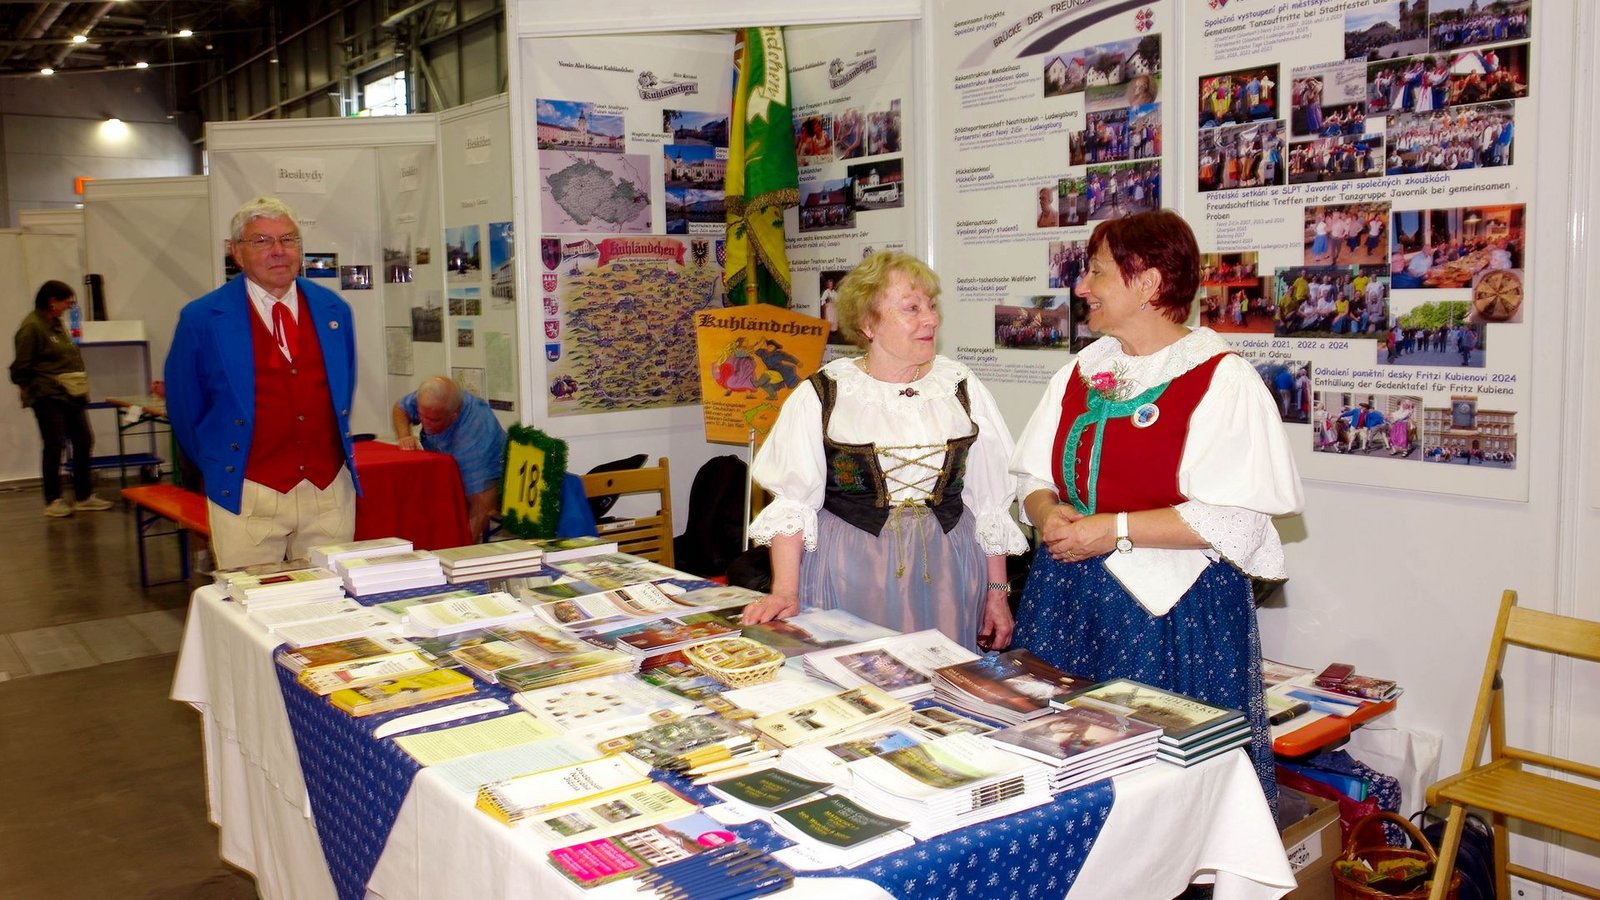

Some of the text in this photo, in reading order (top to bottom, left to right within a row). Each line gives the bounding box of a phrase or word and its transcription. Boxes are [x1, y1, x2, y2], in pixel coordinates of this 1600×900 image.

[1204, 1, 1370, 38] Gemeinsame Tanzauftritte bei Stadtfesten
[1238, 8, 1276, 22] vystoupení
[1278, 4, 1288, 14] při
[954, 16, 982, 28] Gemeinsame
[976, 22, 997, 32] projekty
[993, 22, 1022, 48] BRÜCKE
[1028, 12, 1043, 26] DER
[1044, 110, 1078, 122] Ludwigsburg
[1030, 122, 1062, 132] Ludwigsburg
[1242, 190, 1268, 198] setkání
[1282, 186, 1302, 194] SLPT
[1306, 183, 1338, 193] Javorník
[1342, 180, 1353, 192] při
[1356, 176, 1400, 190] společných
[1405, 174, 1450, 185] zkouškách
[1206, 182, 1510, 210] Freundschaftliche Treffen mit der Tanzgruppe Javorník bei gemeinsamen
[1206, 212, 1230, 220] Proben
[610, 241, 676, 256] Kuhländchen
[698, 314, 822, 336] Kuhländchen
[1243, 340, 1269, 348] Odrách
[1272, 340, 1294, 350] 2021,
[1314, 368, 1516, 382] Odhalení pamětní desky Fritzi Kubienovi 2024
[1314, 378, 1514, 395] Enthüllung der Gedenktafel für Fritz Kubiena
[519, 460, 539, 508] 18
